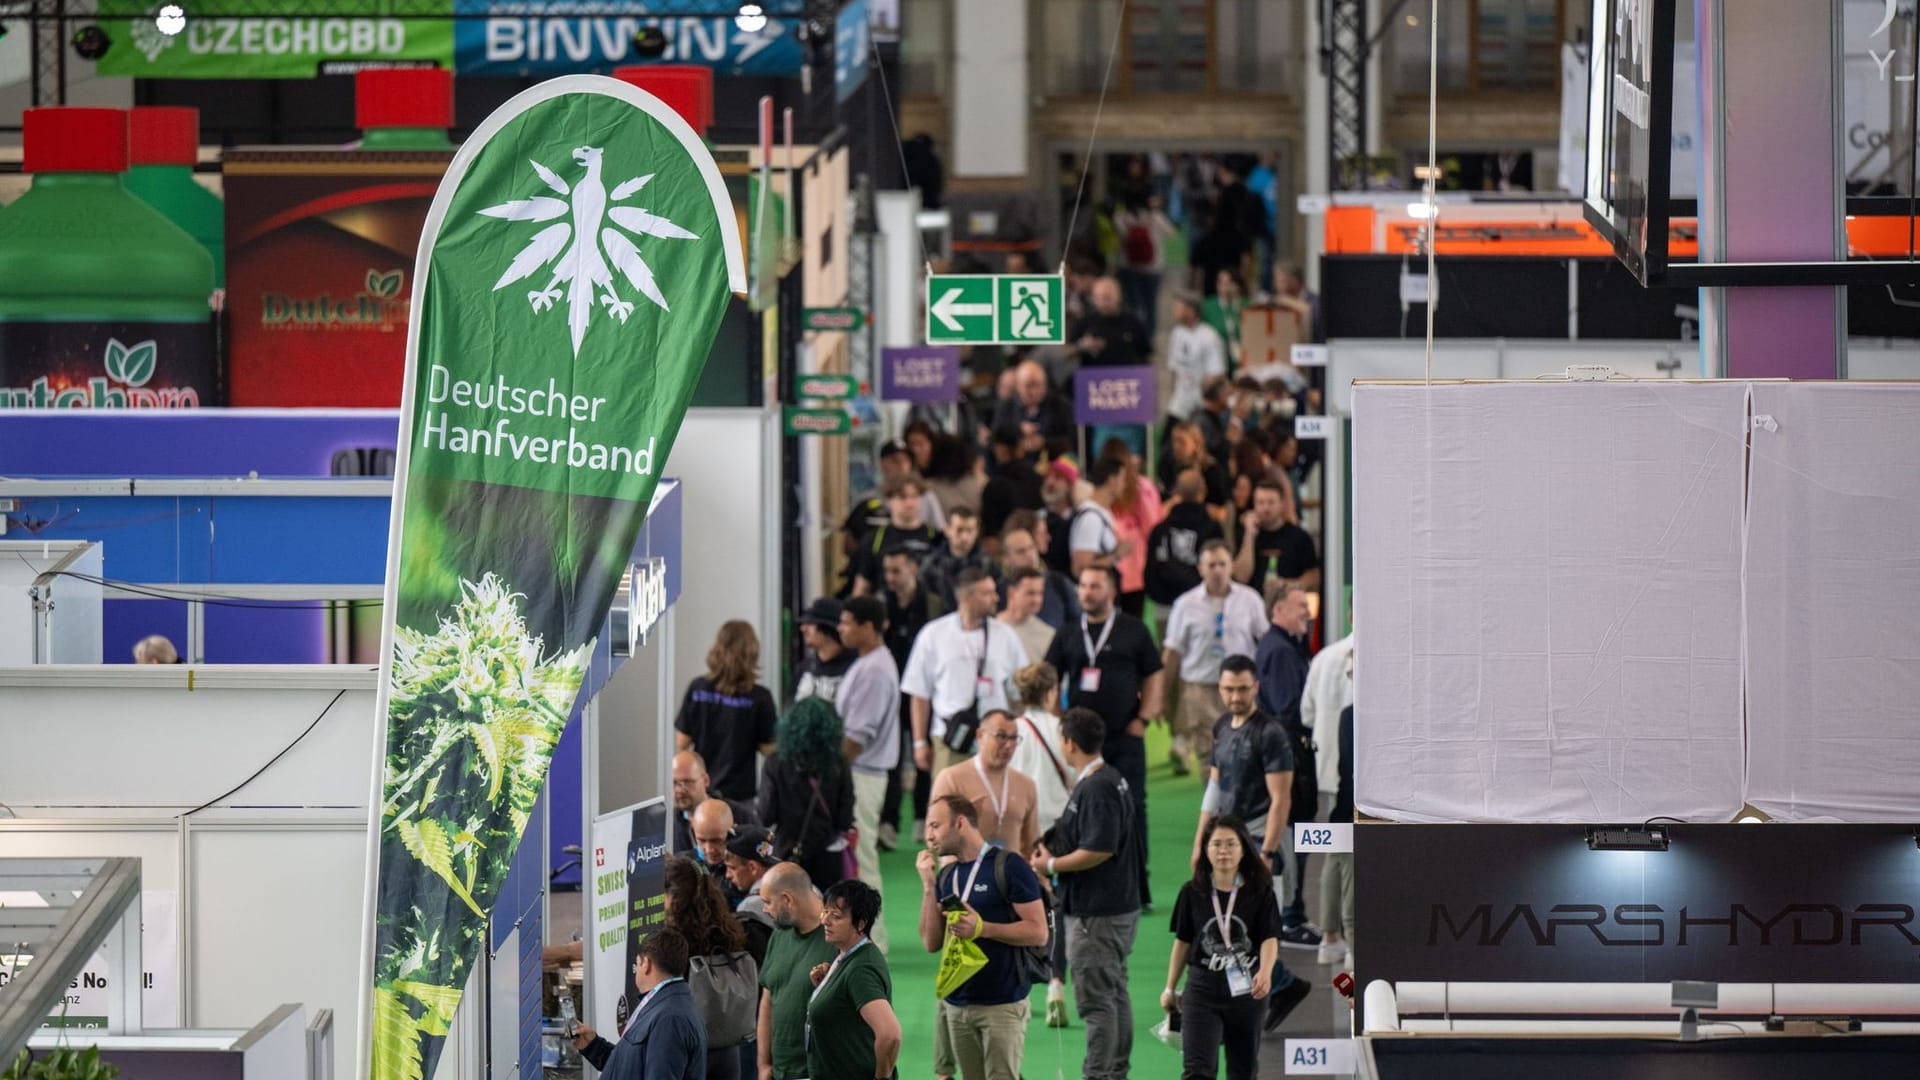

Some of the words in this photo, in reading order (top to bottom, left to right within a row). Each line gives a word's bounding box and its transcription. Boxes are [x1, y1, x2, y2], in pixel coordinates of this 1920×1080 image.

[188, 17, 404, 54] CZECHCBD
[429, 364, 606, 422] Deutscher
[1088, 380, 1139, 395] LOST
[423, 410, 655, 475] Hanfverband
[1301, 829, 1332, 846] A32
[597, 869, 625, 896] SWISS
[598, 901, 626, 922] PREMIUM
[599, 926, 627, 952] QUALITY
[1293, 1047, 1327, 1065] A31
